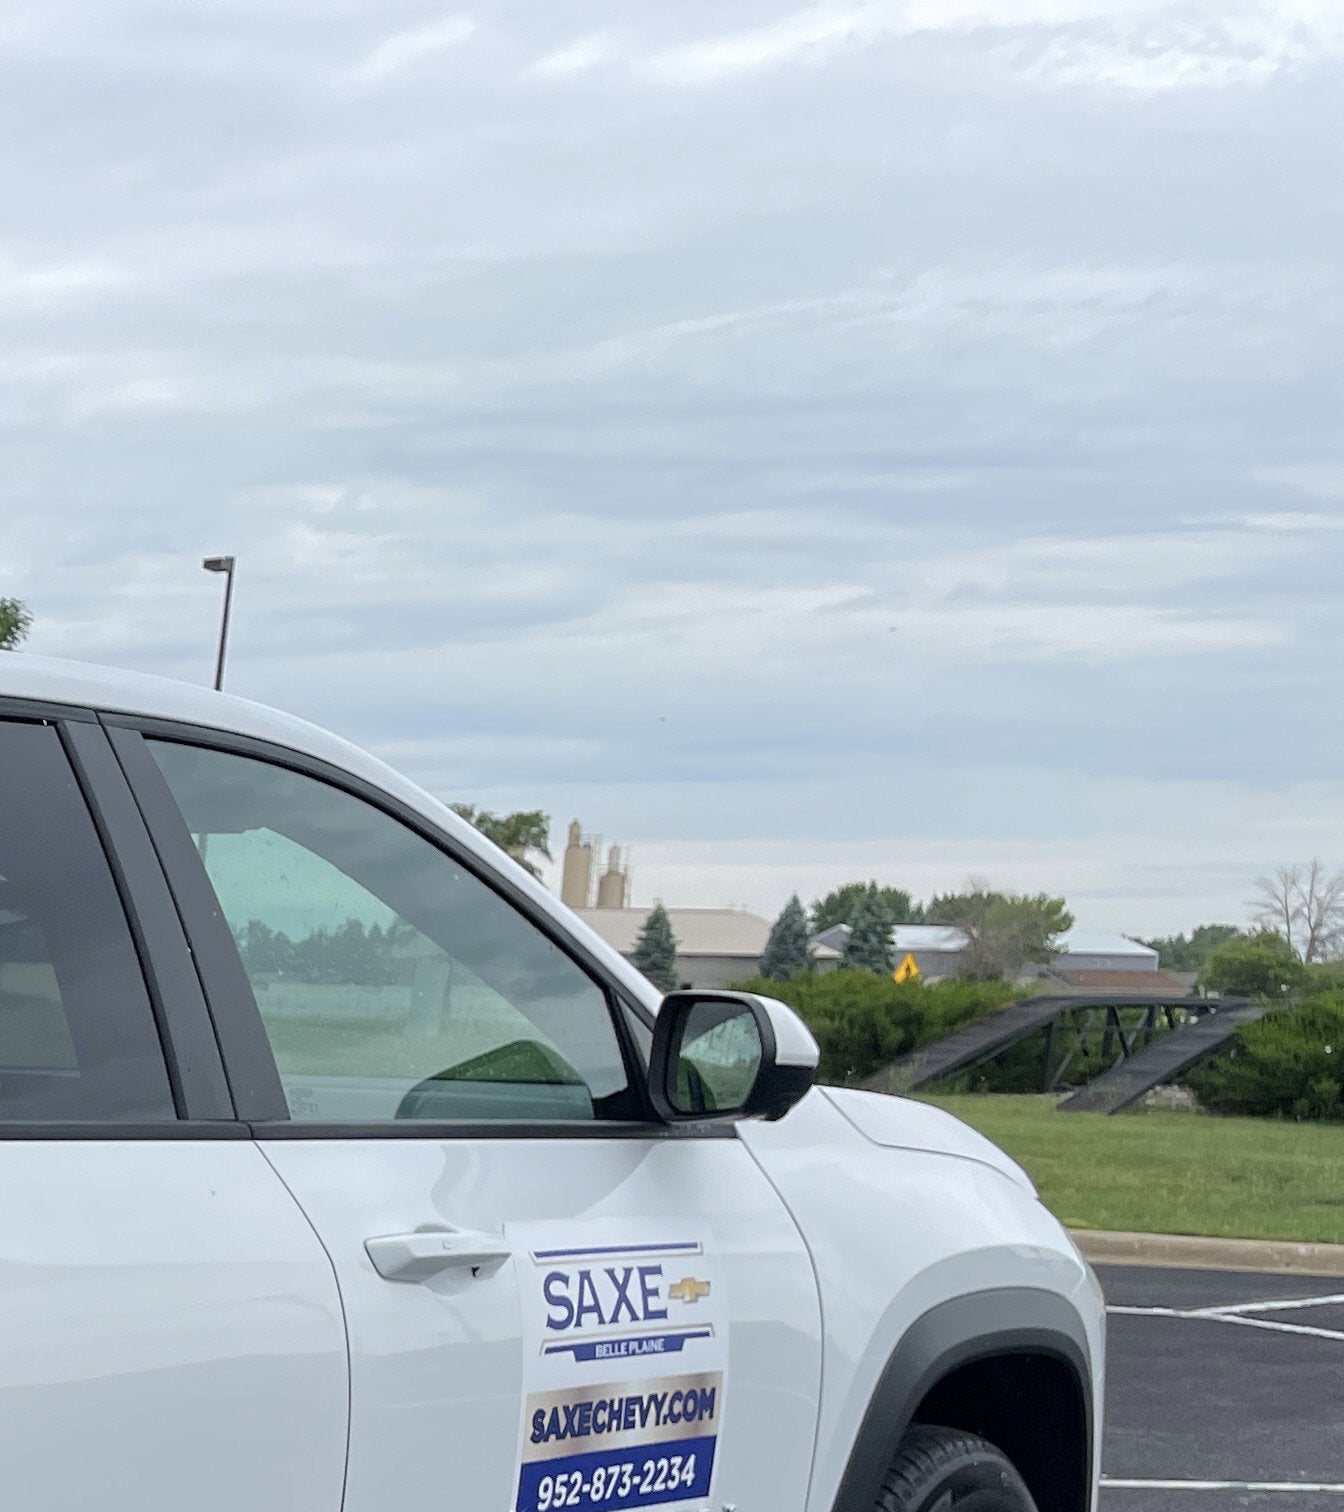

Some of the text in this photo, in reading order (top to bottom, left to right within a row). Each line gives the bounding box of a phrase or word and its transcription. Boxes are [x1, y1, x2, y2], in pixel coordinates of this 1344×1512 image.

[543, 1264, 668, 1331] SAXE
[595, 1338, 665, 1358] BELLE PLAINE
[530, 1387, 716, 1444] SAXECHEVY.COM
[536, 1454, 698, 1512] 952-873-2234
